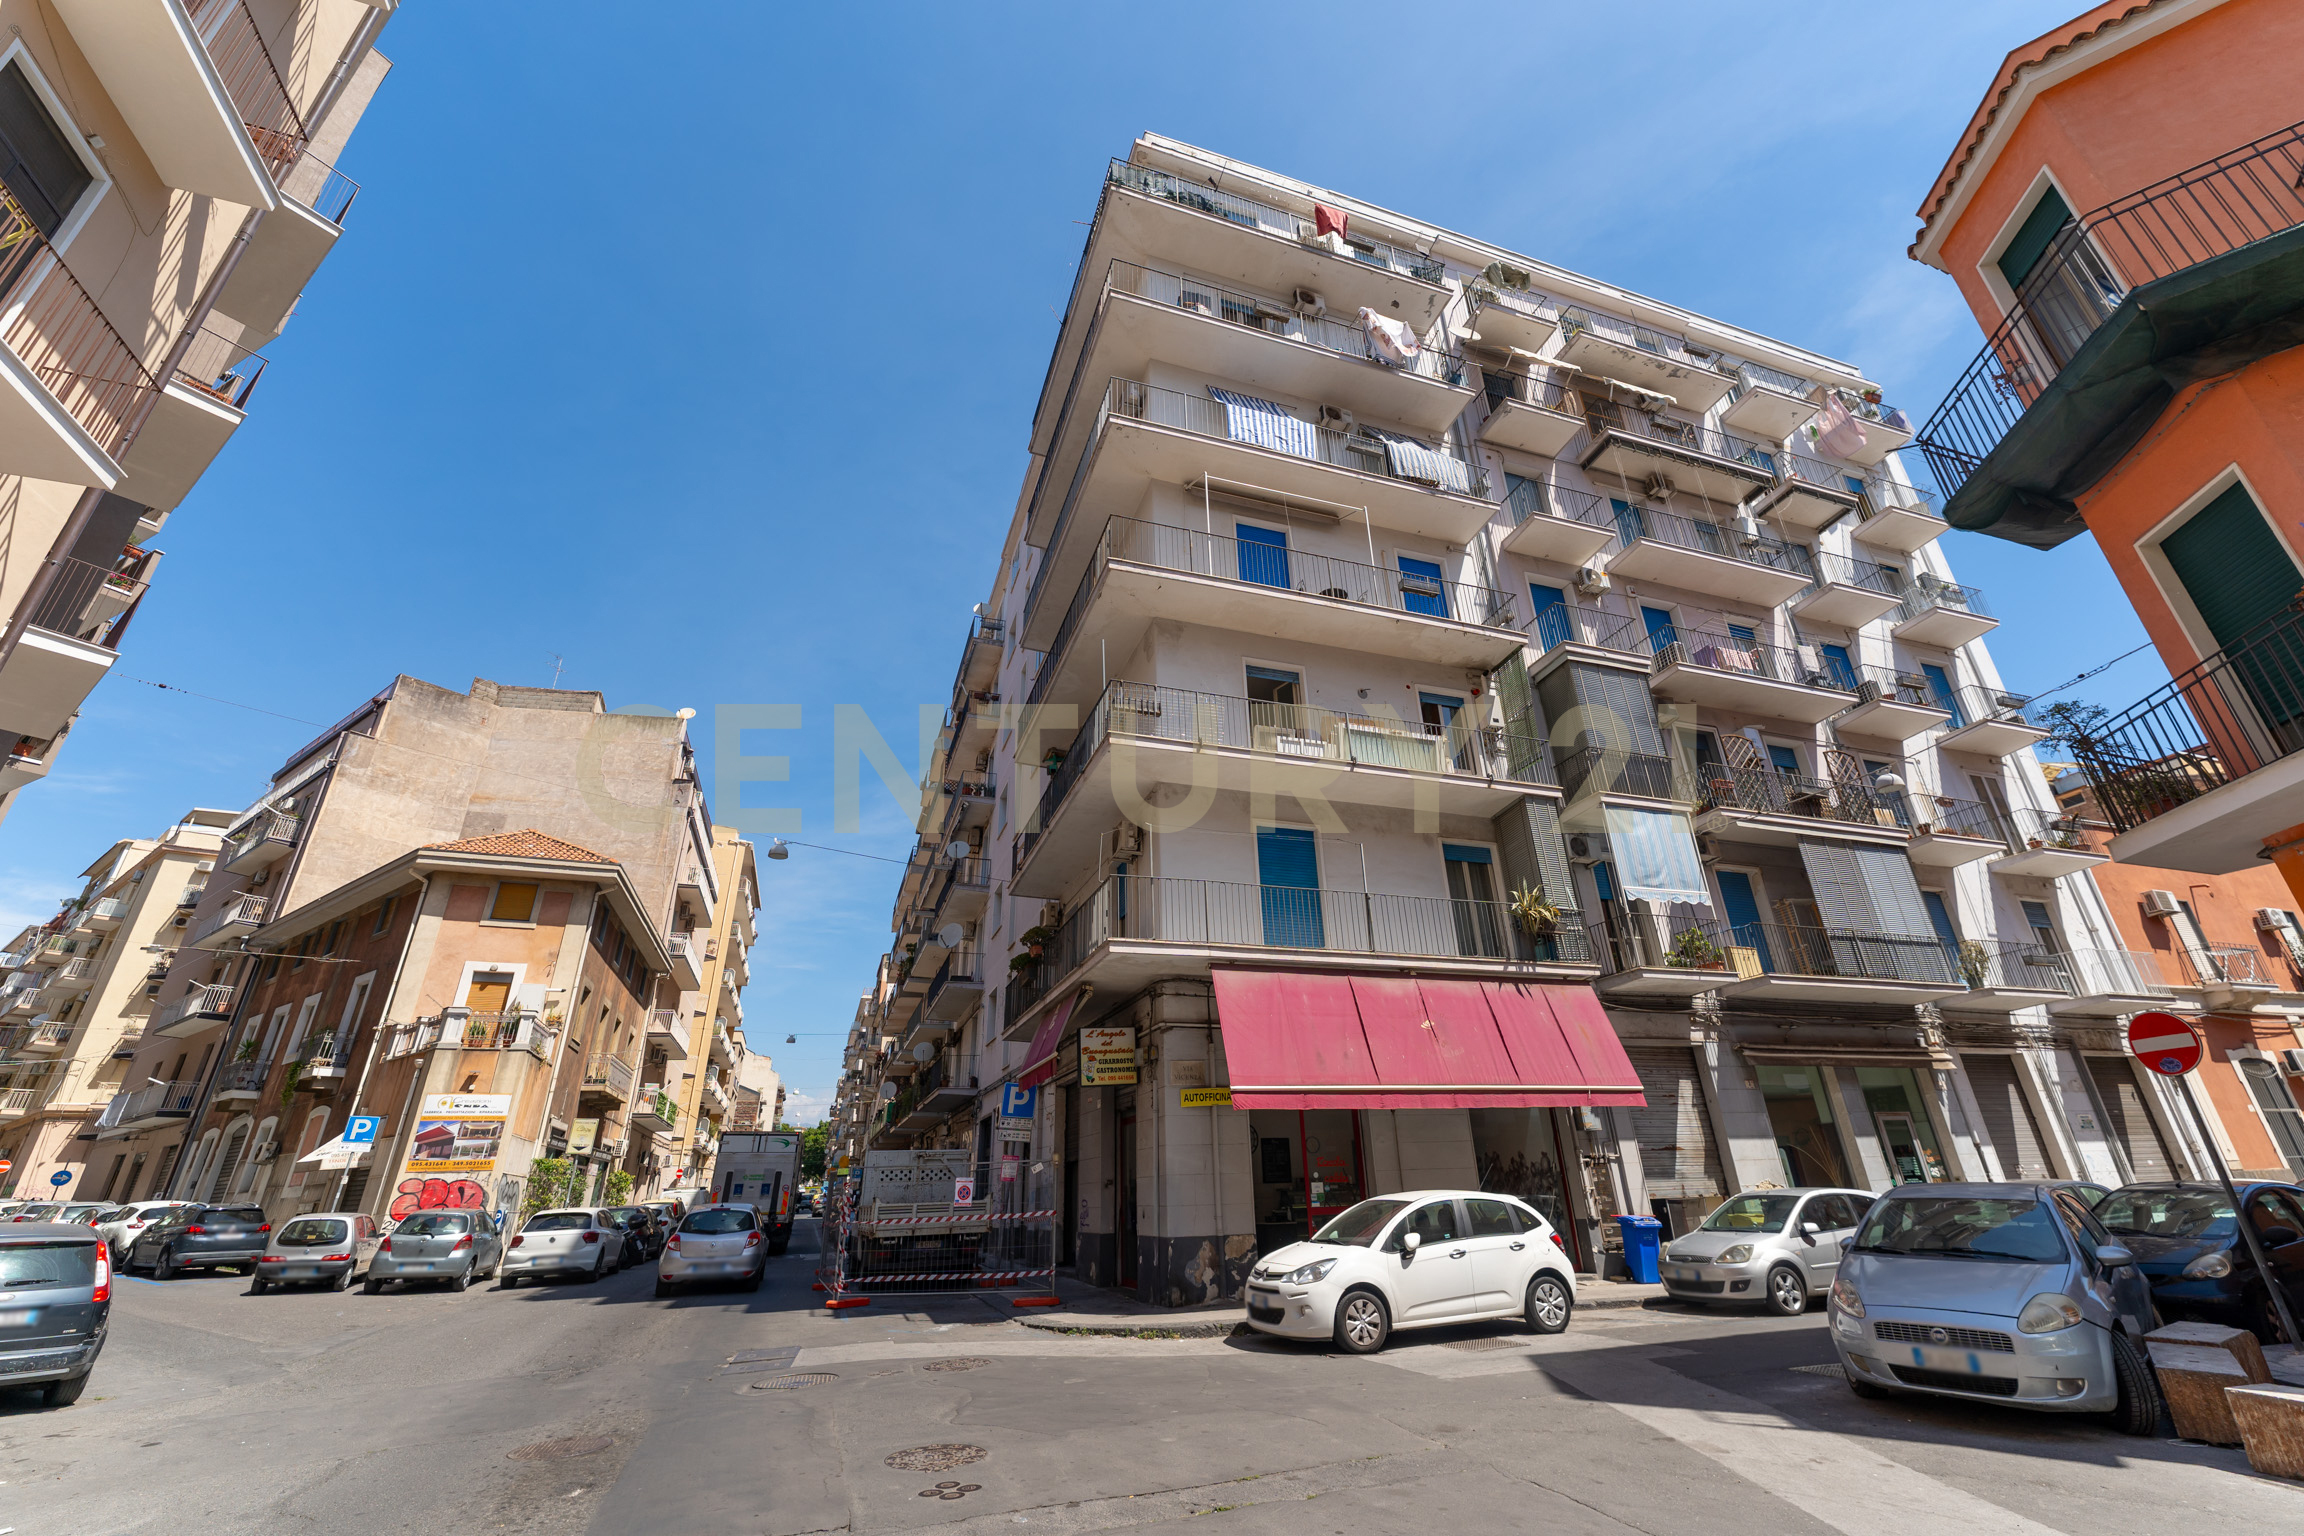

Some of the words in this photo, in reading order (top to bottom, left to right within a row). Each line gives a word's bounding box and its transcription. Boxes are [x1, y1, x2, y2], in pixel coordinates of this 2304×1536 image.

[1085, 1029, 1126, 1040] L'Angolo
[1098, 1057, 1134, 1065] GIRARROSTO
[1096, 1066, 1137, 1074] GASTRONOMIA
[1007, 1086, 1030, 1114] P
[1183, 1092, 1232, 1102] AUTOFFICINA
[349, 1119, 372, 1140] P
